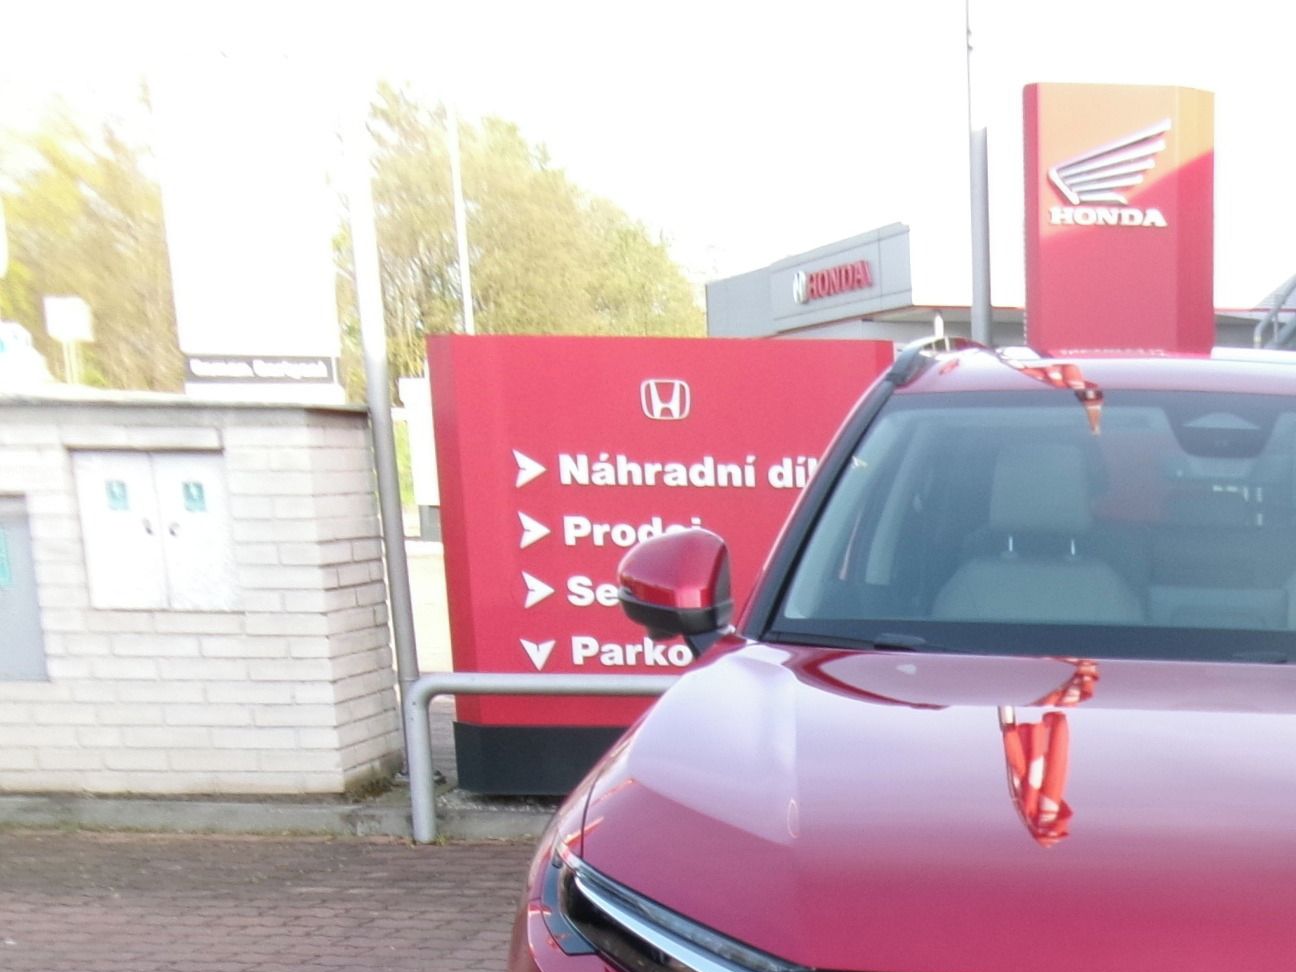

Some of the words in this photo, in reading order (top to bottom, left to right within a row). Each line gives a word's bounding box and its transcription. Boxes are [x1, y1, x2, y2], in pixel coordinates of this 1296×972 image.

[1048, 206, 1168, 228] HONDA
[808, 260, 873, 299] HONDA
[558, 452, 757, 488] Náhradní
[571, 635, 694, 667] Parko
